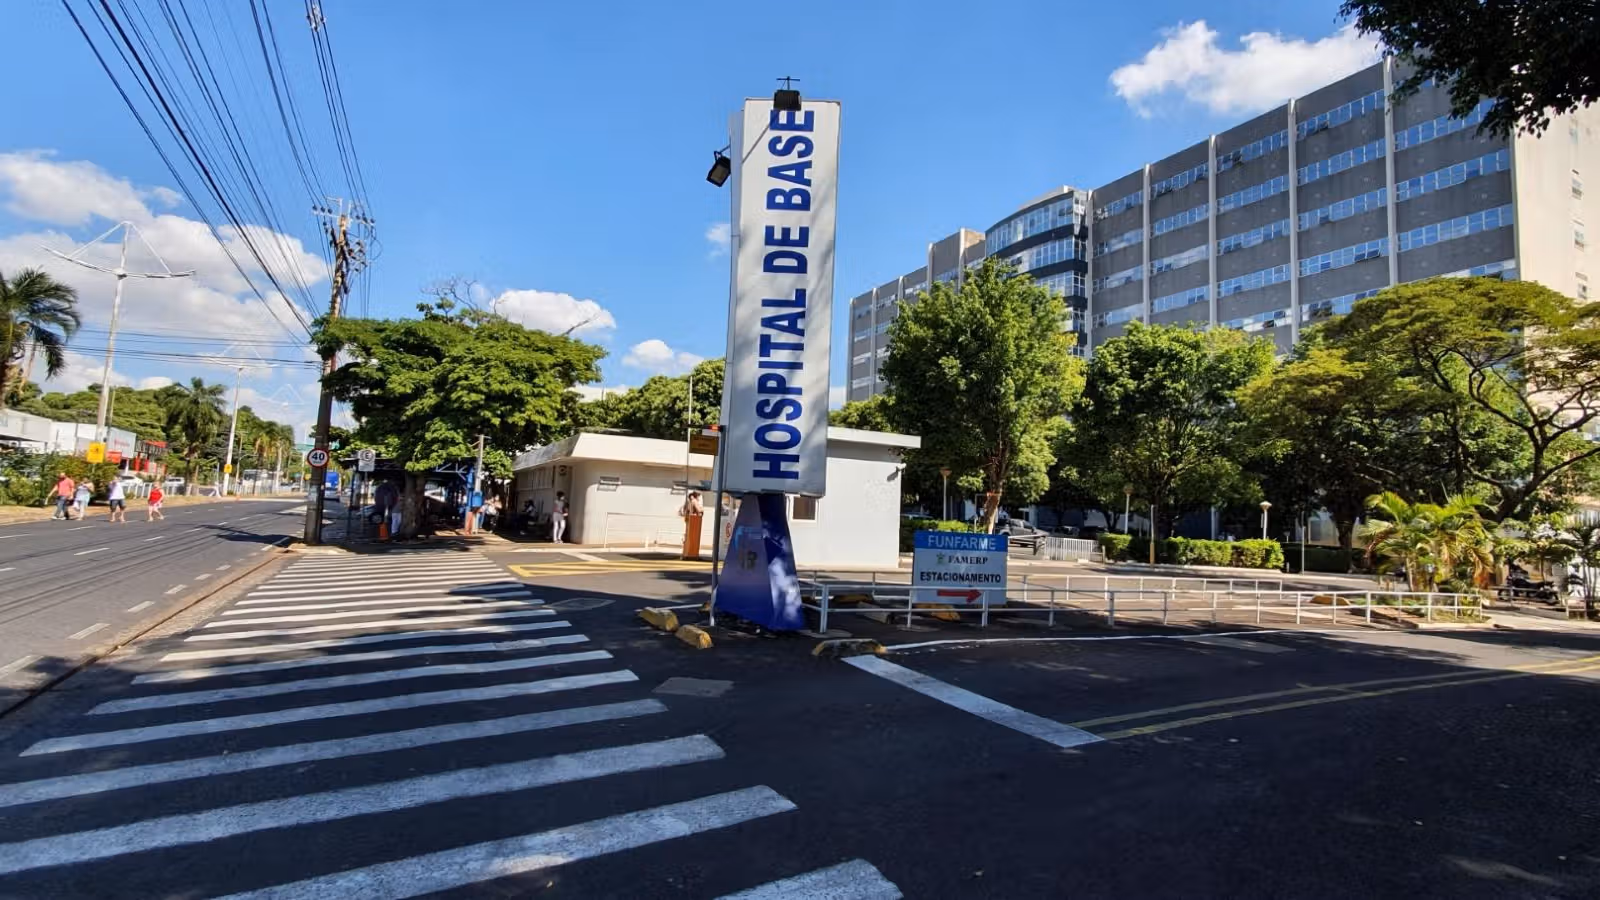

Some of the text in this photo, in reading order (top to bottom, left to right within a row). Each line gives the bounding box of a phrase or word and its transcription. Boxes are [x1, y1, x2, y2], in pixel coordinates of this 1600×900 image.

[753, 109, 815, 480] HOSPITAL DE BASE
[312, 452, 325, 461] 40
[928, 535, 996, 550] FUNFARME
[948, 555, 988, 565] FAMERP
[920, 571, 1002, 583] ESTACIONAMENTO
